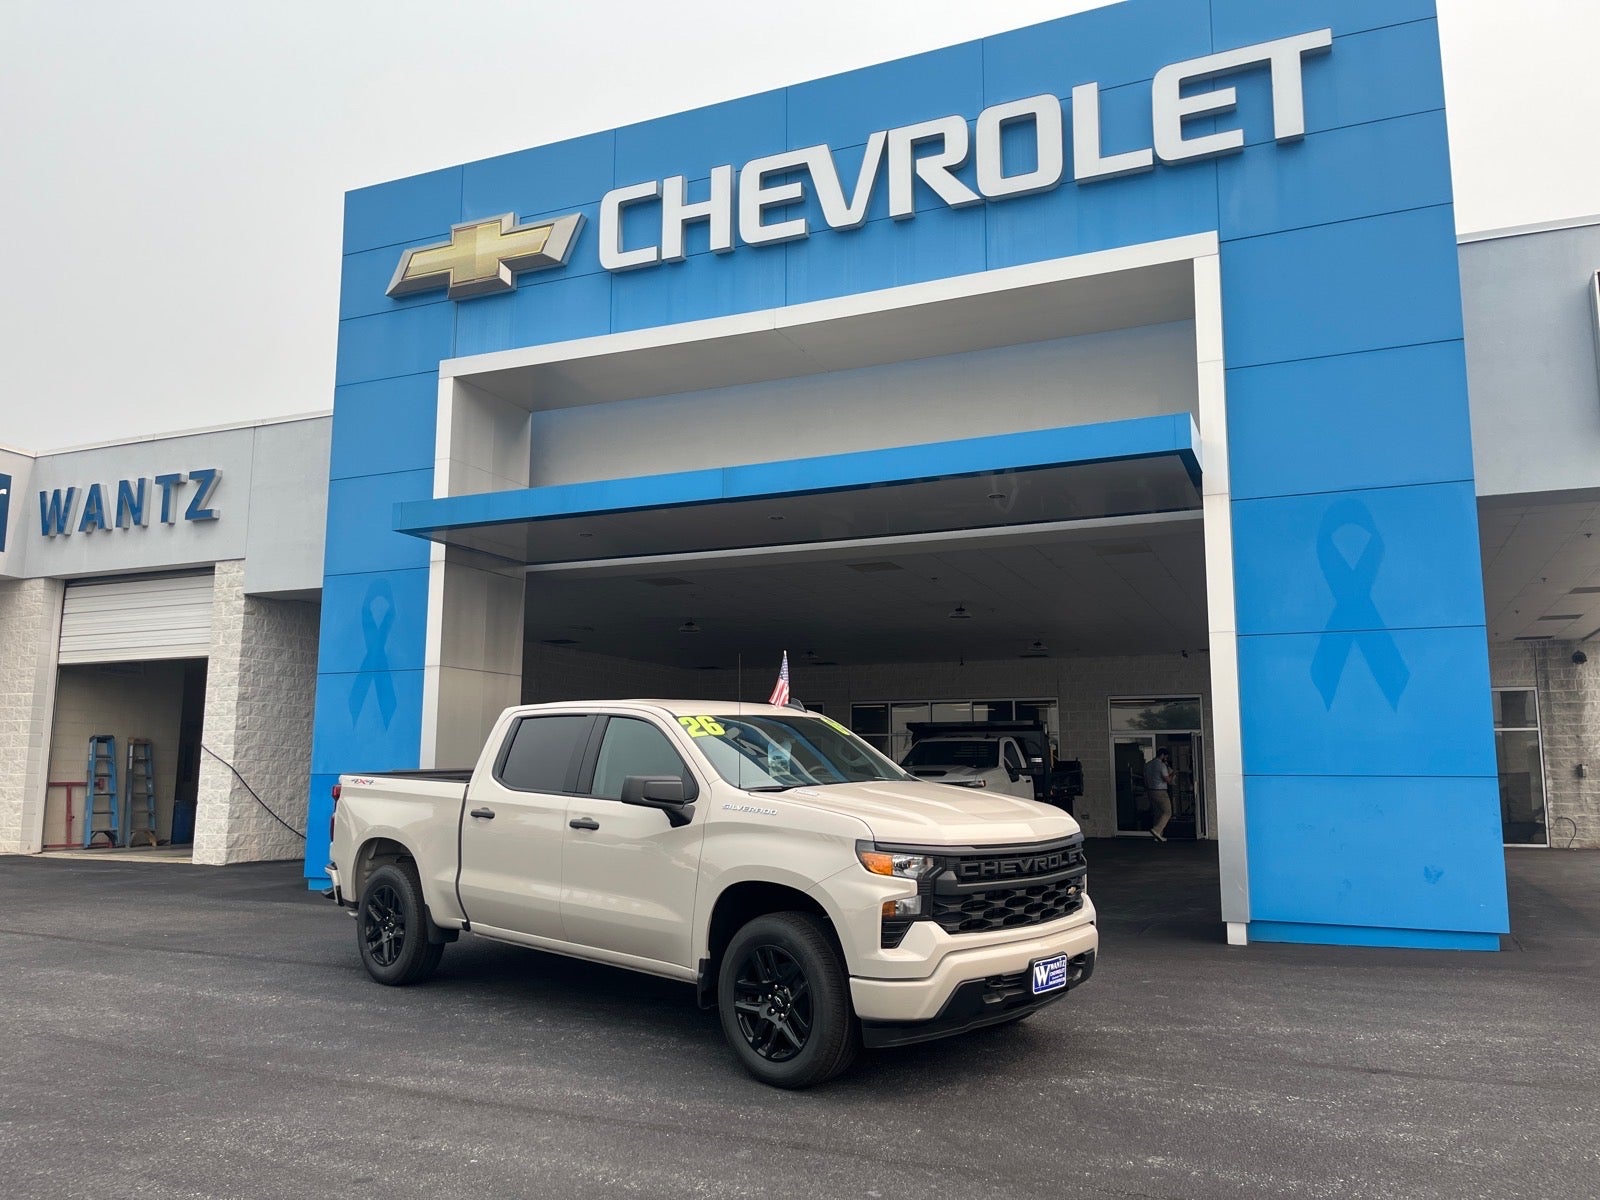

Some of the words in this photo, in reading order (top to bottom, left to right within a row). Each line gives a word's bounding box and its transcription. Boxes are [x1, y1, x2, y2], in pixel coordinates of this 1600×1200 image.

[599, 27, 1333, 273] CHEVROLET
[39, 468, 222, 537] WANTZ
[677, 715, 726, 738] 26
[722, 803, 779, 816] SILVERADO
